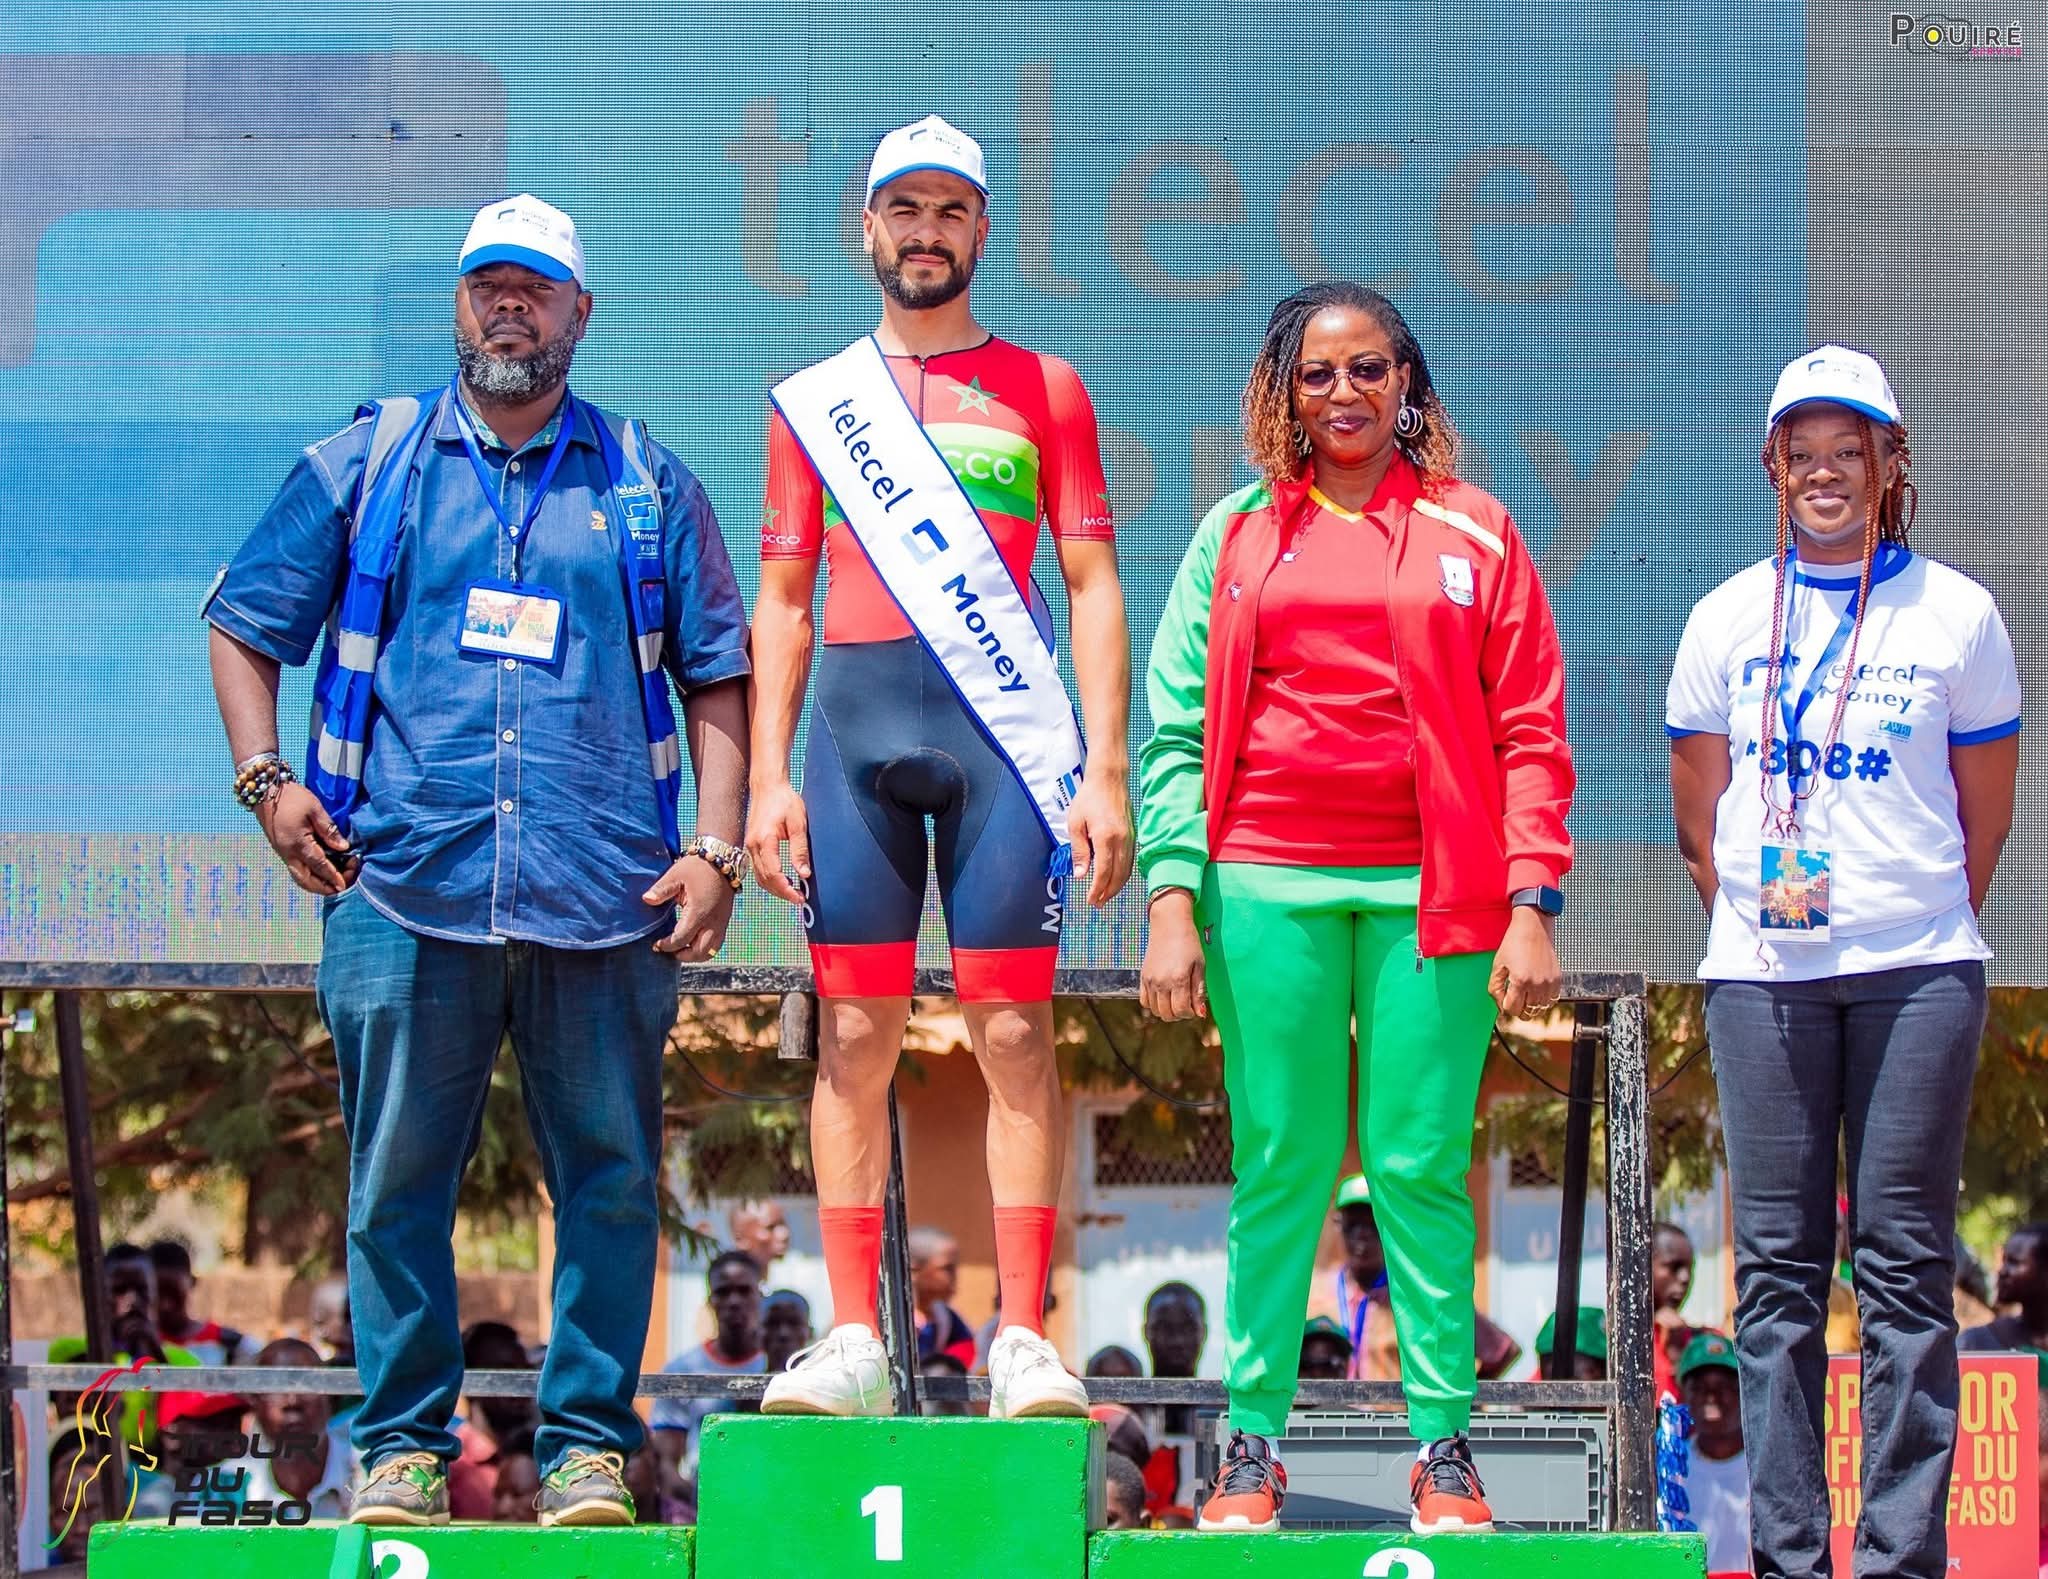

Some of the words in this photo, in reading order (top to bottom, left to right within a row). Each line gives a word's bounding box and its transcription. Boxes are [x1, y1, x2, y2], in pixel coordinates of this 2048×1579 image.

[724, 62, 1678, 304] tlecel
[631, 530, 660, 543] Money
[829, 399, 913, 512] telecel
[941, 573, 1031, 693] Money
[1974, 1435, 2017, 1481] DU
[860, 1485, 903, 1561] 1
